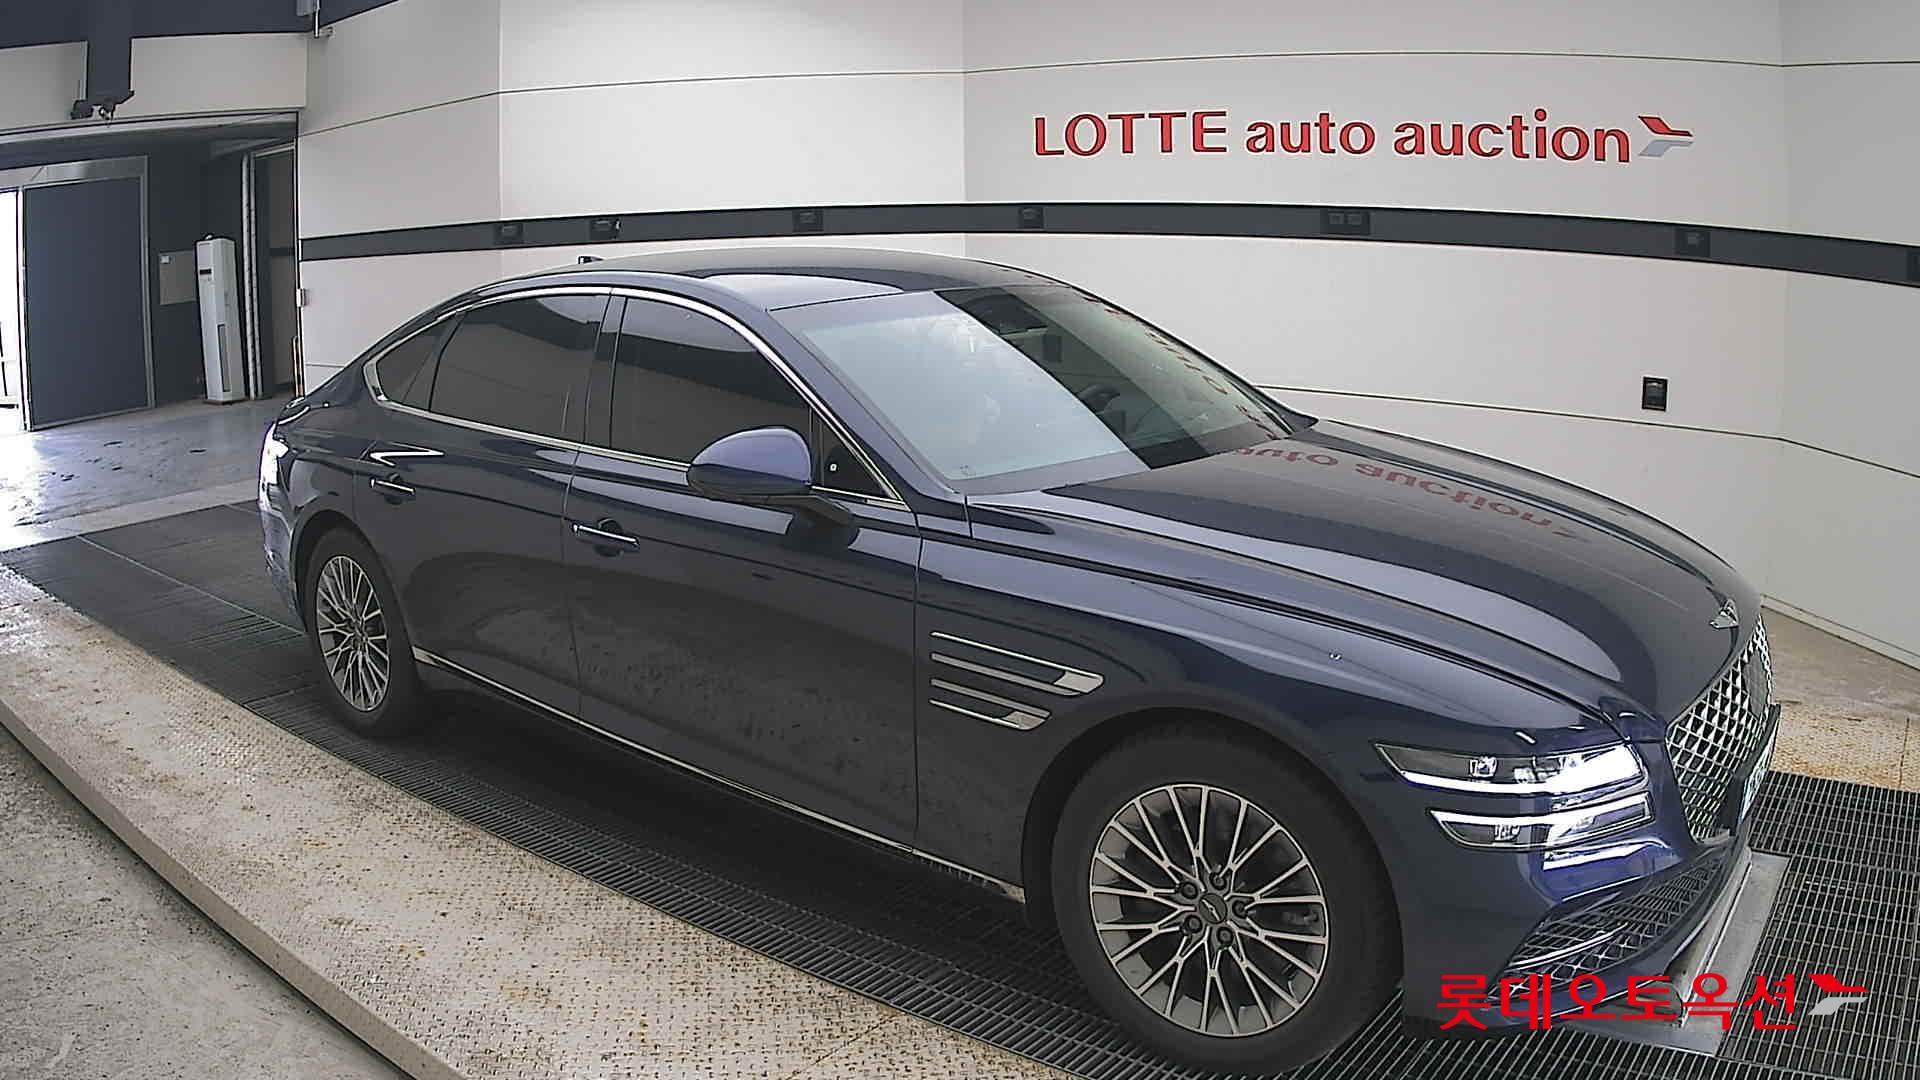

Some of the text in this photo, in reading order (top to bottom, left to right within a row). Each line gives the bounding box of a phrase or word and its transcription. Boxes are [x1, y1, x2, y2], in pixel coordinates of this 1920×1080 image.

[1035, 108, 1630, 163] LOTTE auto auction
